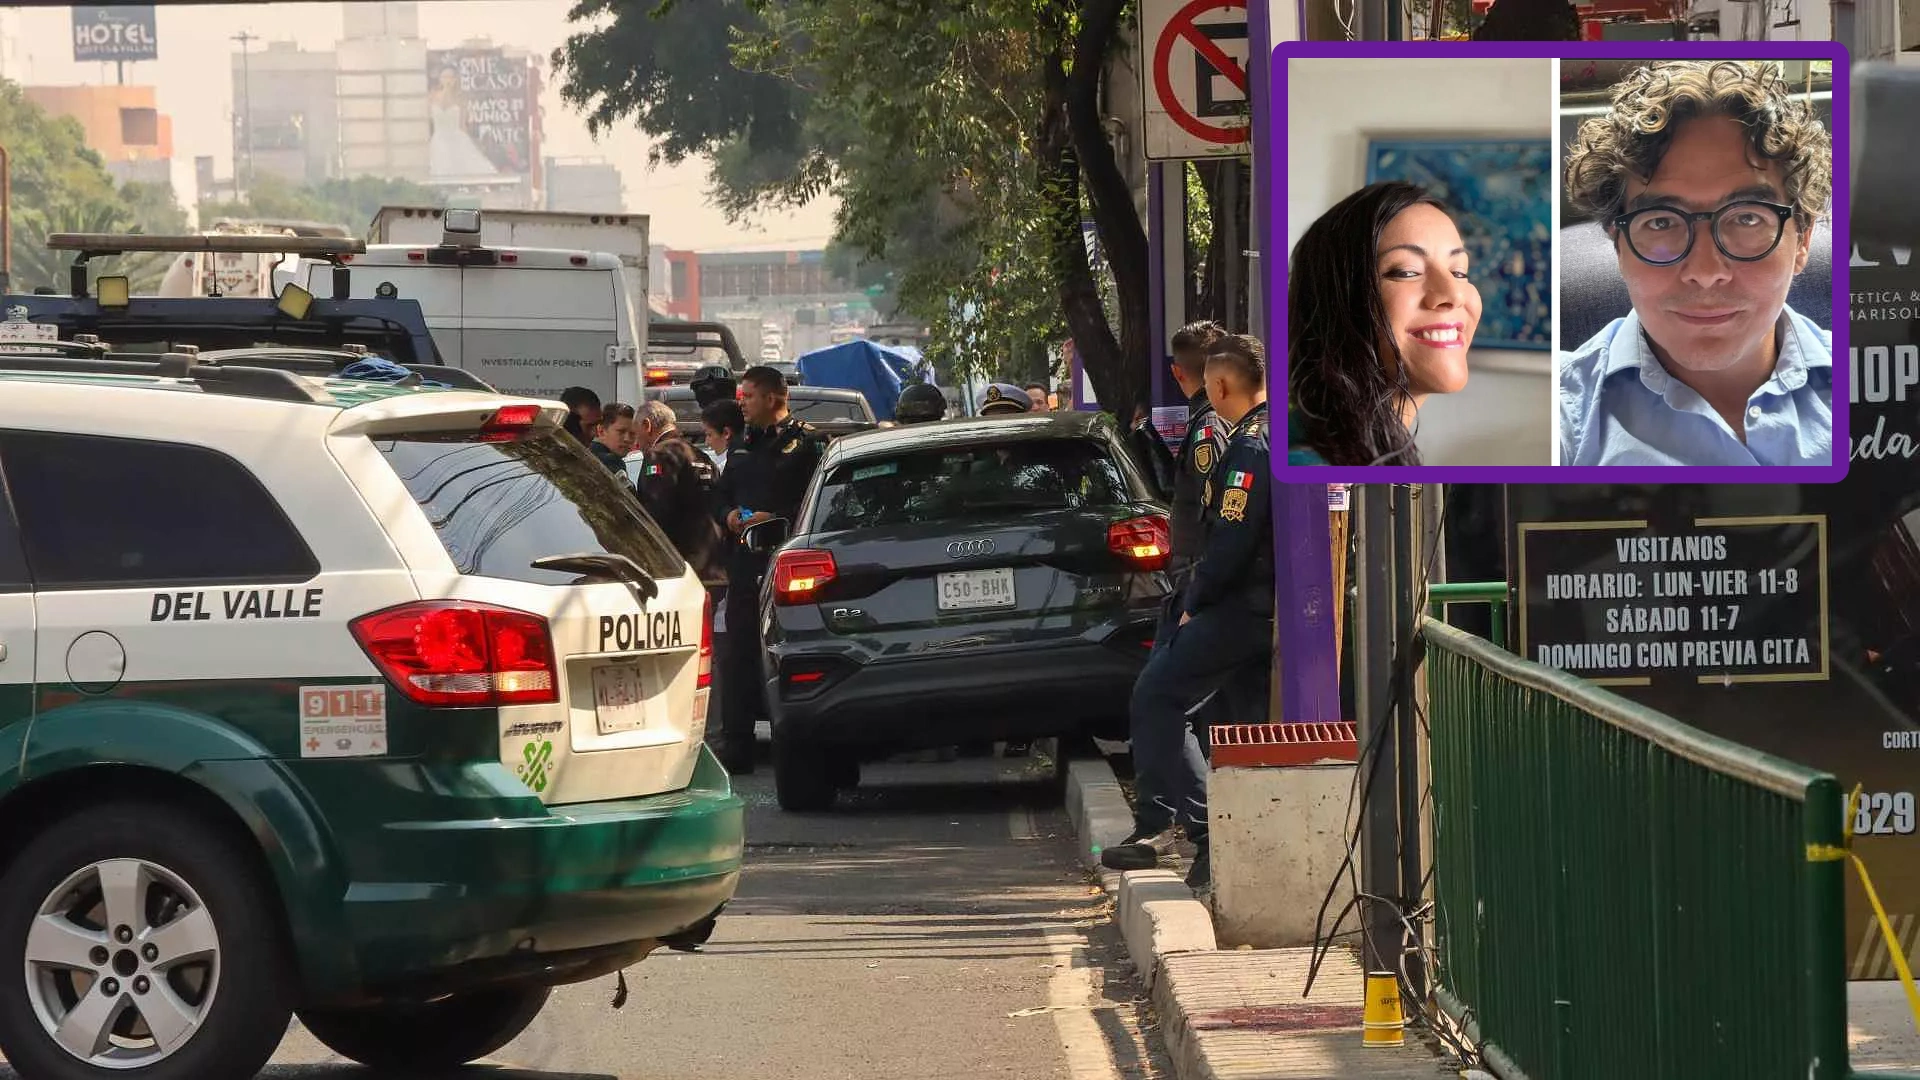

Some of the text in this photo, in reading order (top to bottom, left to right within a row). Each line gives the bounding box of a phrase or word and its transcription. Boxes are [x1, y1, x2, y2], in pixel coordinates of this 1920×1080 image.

[76, 23, 154, 45] HOTEL
[471, 73, 522, 91] CASO
[467, 98, 508, 112] MAYO
[481, 357, 594, 368] INVESTIGACIÓN FORENSE
[1616, 535, 1727, 563] VISITANOS
[1546, 568, 1799, 600] HORARIO: LUN-VIER 11-8
[150, 588, 324, 622] DEL VALLE
[1606, 604, 1740, 633] SÁBADO 11-7
[600, 611, 682, 652] POLICIA
[1538, 638, 1811, 670] DOMINGO CON PREVIA CITA
[309, 692, 376, 715] 911
[1882, 731, 1920, 750] CORT
[1843, 791, 1915, 835] 829
